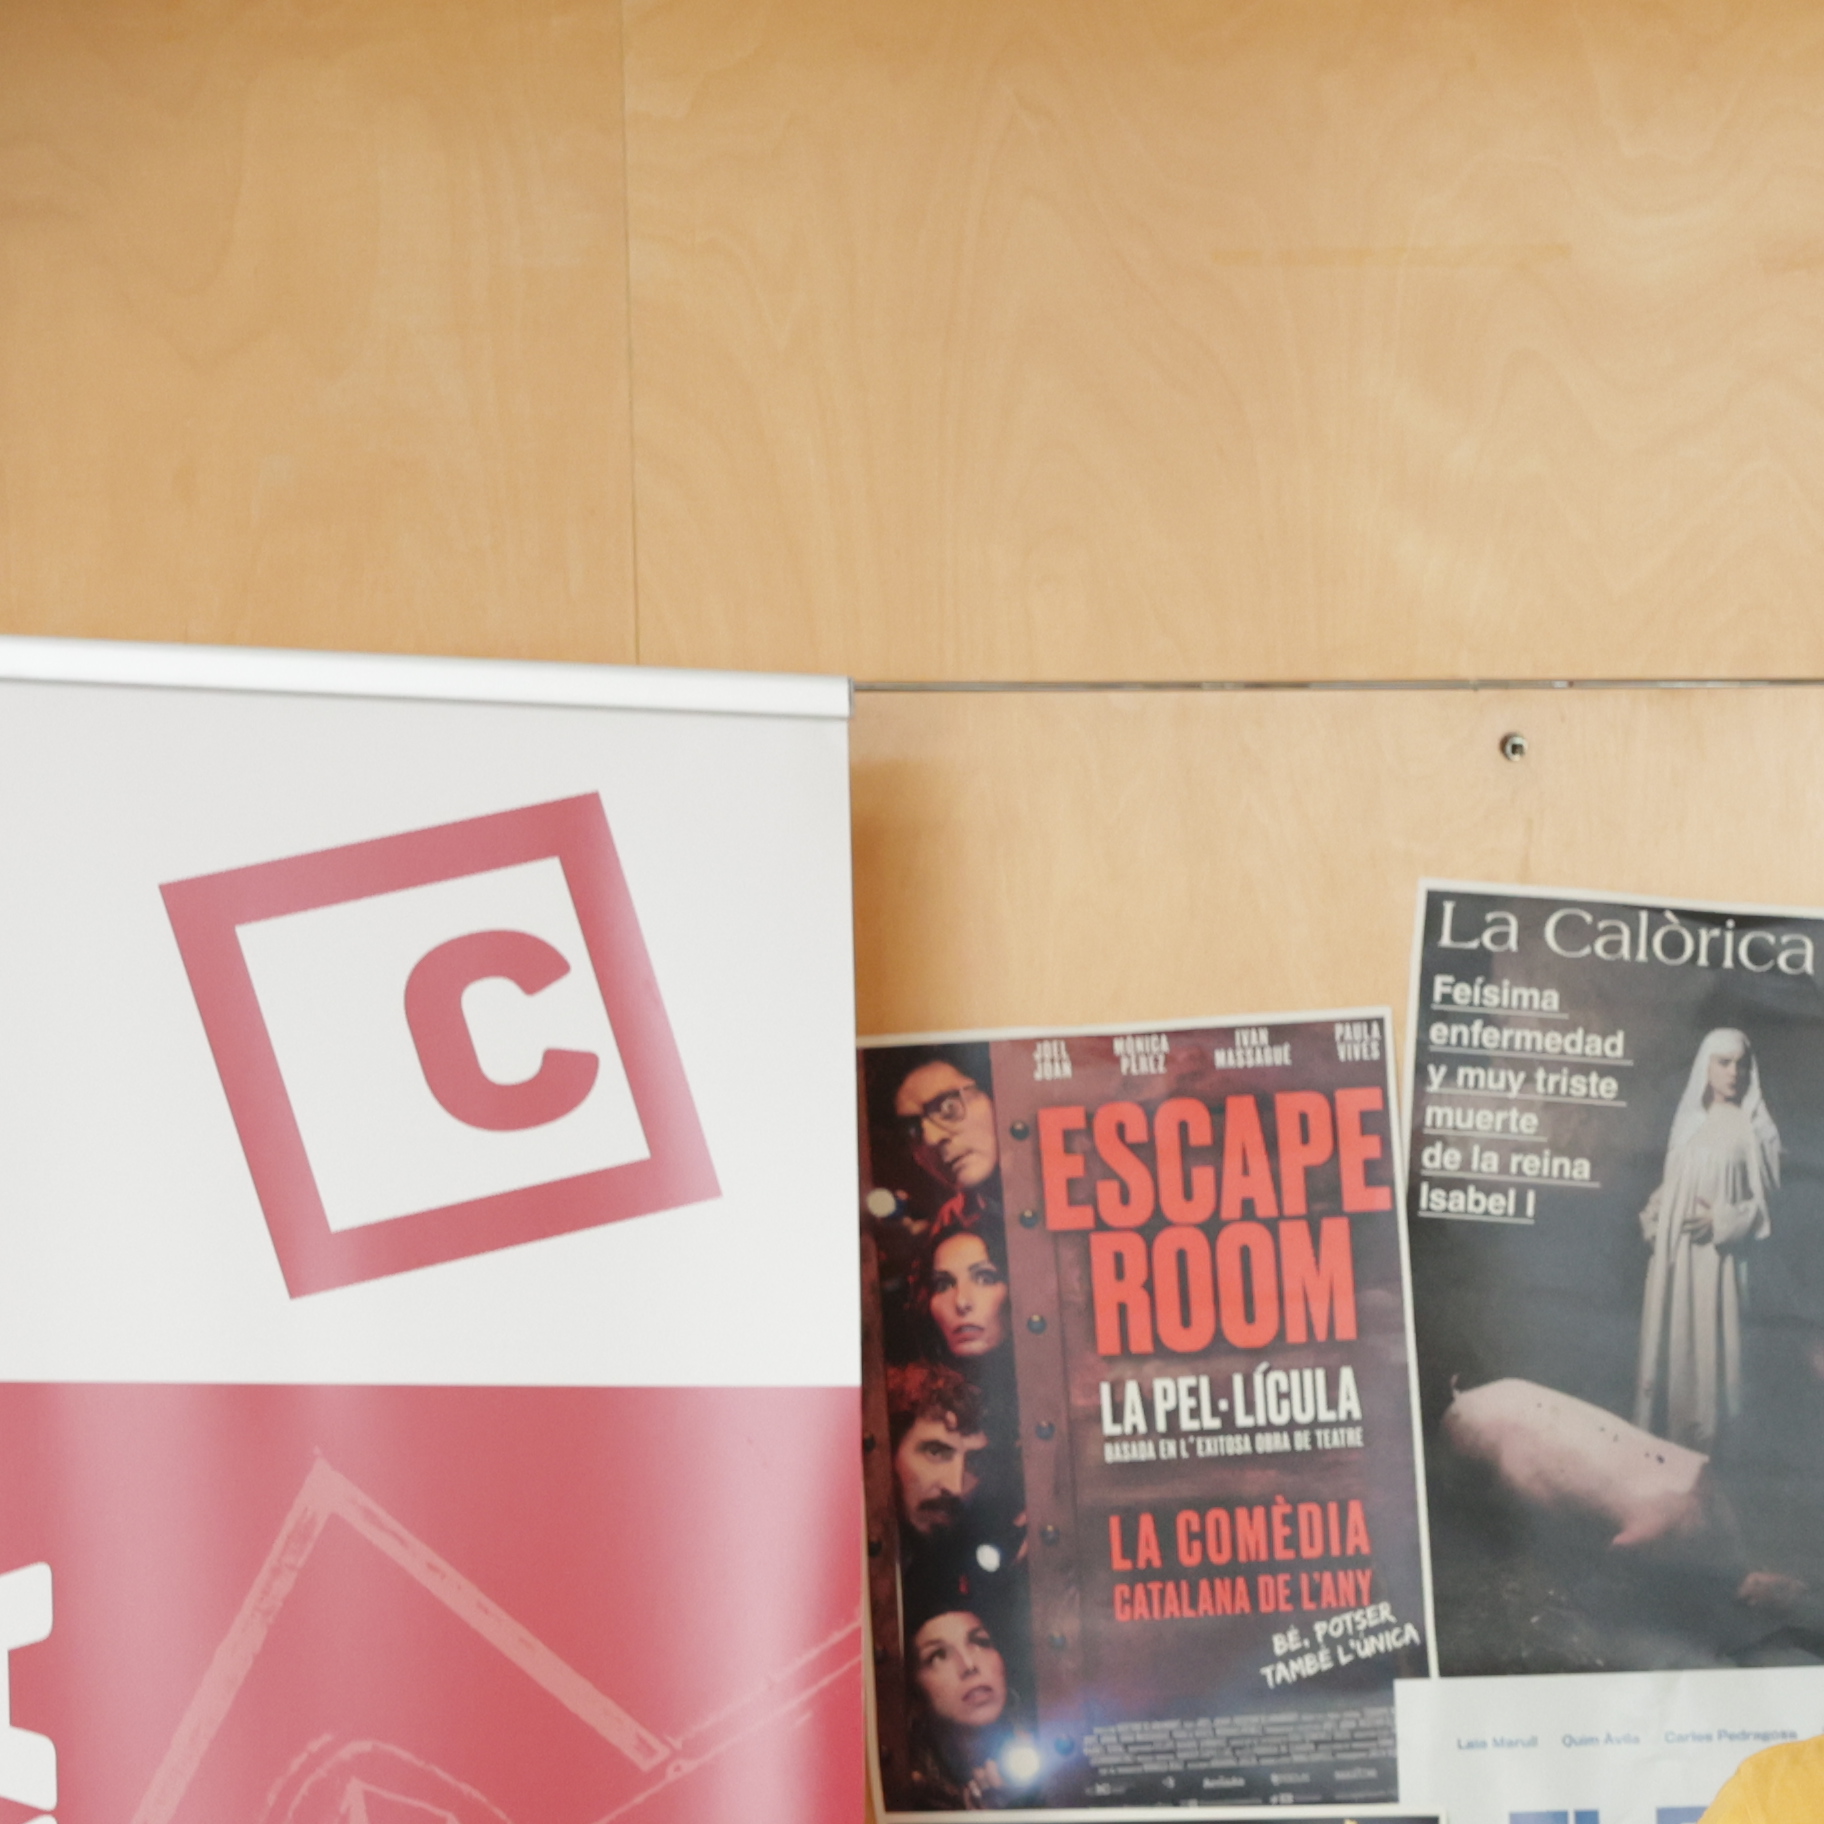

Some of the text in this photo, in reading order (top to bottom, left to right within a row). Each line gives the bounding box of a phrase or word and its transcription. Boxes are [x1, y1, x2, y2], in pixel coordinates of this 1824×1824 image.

[1437, 900, 1815, 976] La Calòrica
[1432, 975, 1560, 1011] Feísima
[404, 929, 600, 1133] C
[1335, 1021, 1381, 1042] PAULA
[1429, 1019, 1625, 1059] enfermedad
[1427, 1063, 1619, 1099] y muy triste
[1423, 1106, 1539, 1135] muerte
[1037, 1086, 1393, 1231] ESCAPE
[1421, 1143, 1591, 1180] de la reina
[1419, 1183, 1535, 1217] Isabel I
[1089, 1217, 1358, 1357] ROOM
[1099, 1361, 1363, 1437] LA PEL·LÍCULA
[1315, 1426, 1365, 1450] TEATRE
[1109, 1494, 1372, 1571] LA COMÈDIA
[1113, 1568, 1372, 1623] CATALANA DE L'ANY
[1314, 1601, 1397, 1650] POTSER
